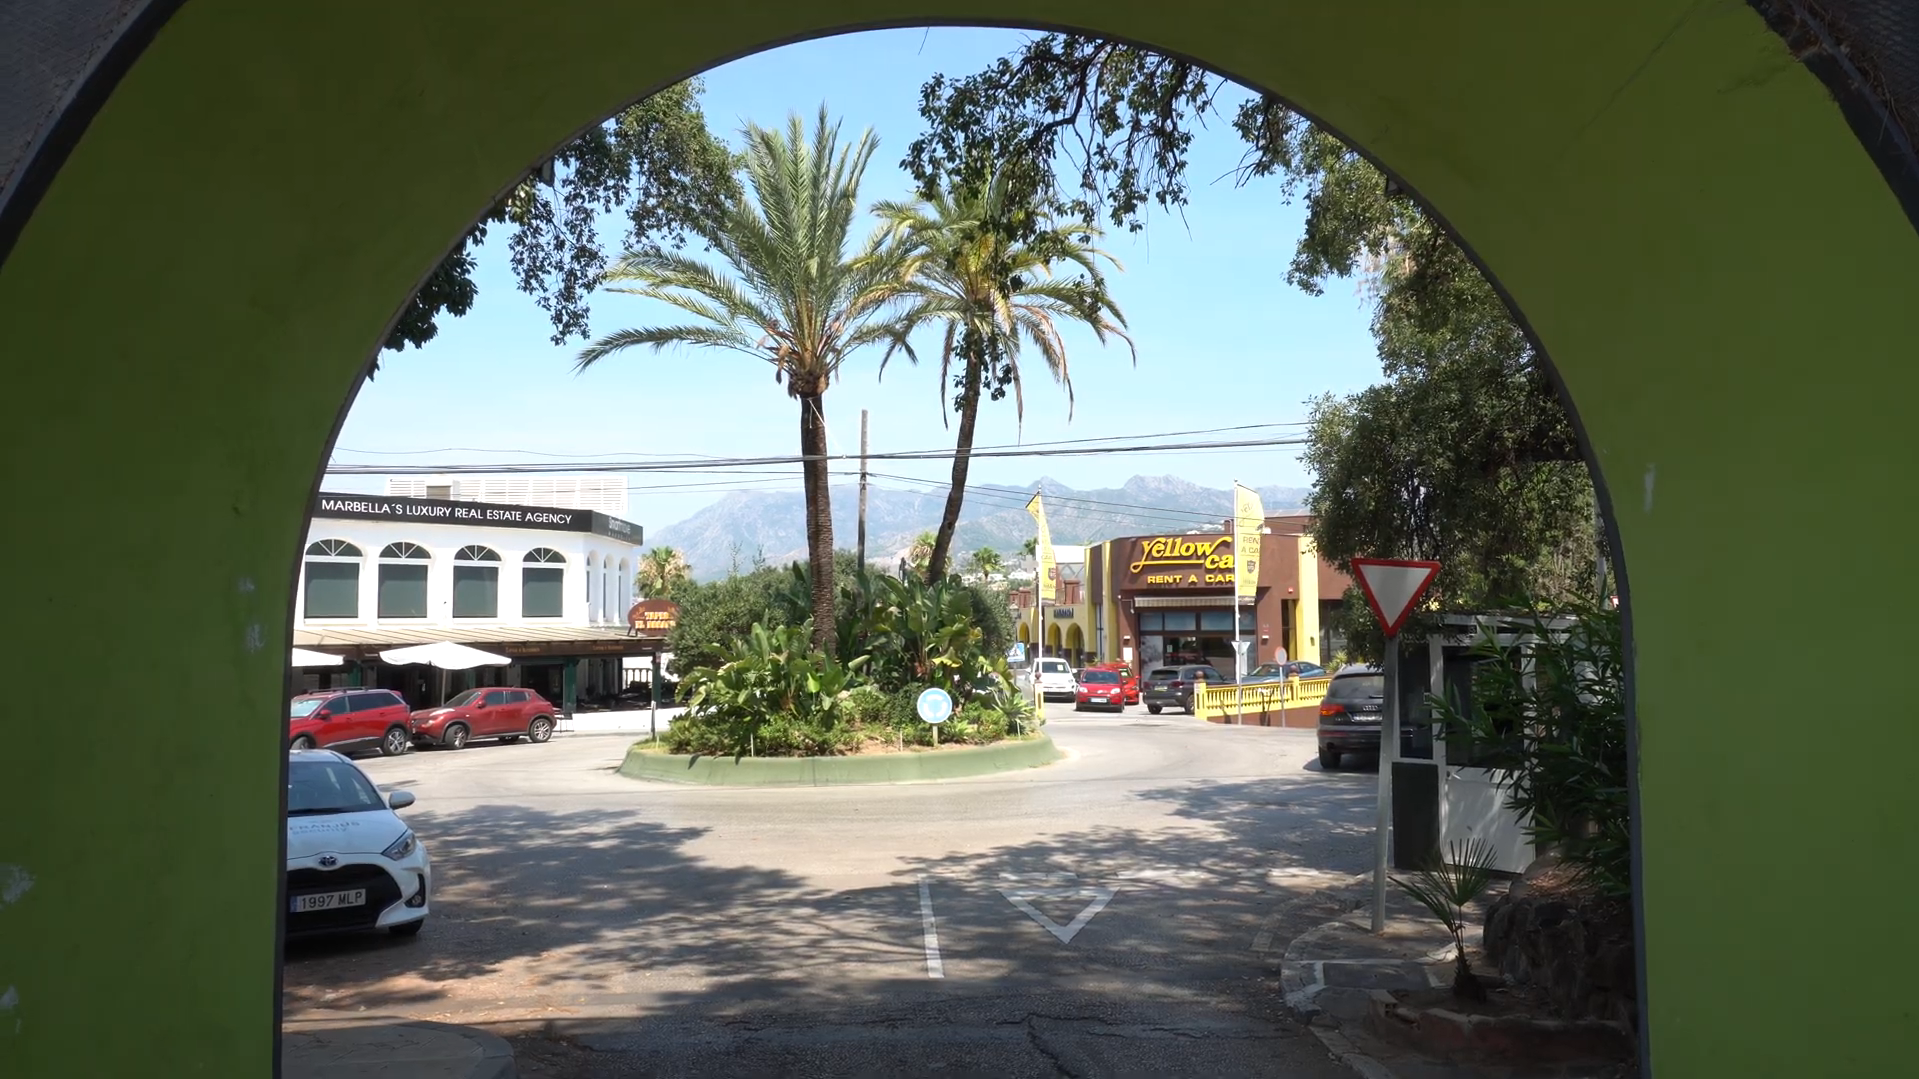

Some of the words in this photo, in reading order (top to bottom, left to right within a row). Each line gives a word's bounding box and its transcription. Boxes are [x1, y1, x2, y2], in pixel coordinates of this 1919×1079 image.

[406, 504, 452, 517] LUXURY
[454, 507, 484, 519] REAL
[486, 509, 522, 521] ESTATE
[524, 511, 572, 524] AGENCY
[1203, 553, 1235, 570] ca
[1146, 574, 1183, 584] RENT
[1187, 574, 1199, 583] A
[1204, 574, 1235, 583] CAR
[302, 894, 335, 910] 1997
[337, 891, 363, 906] MLP
